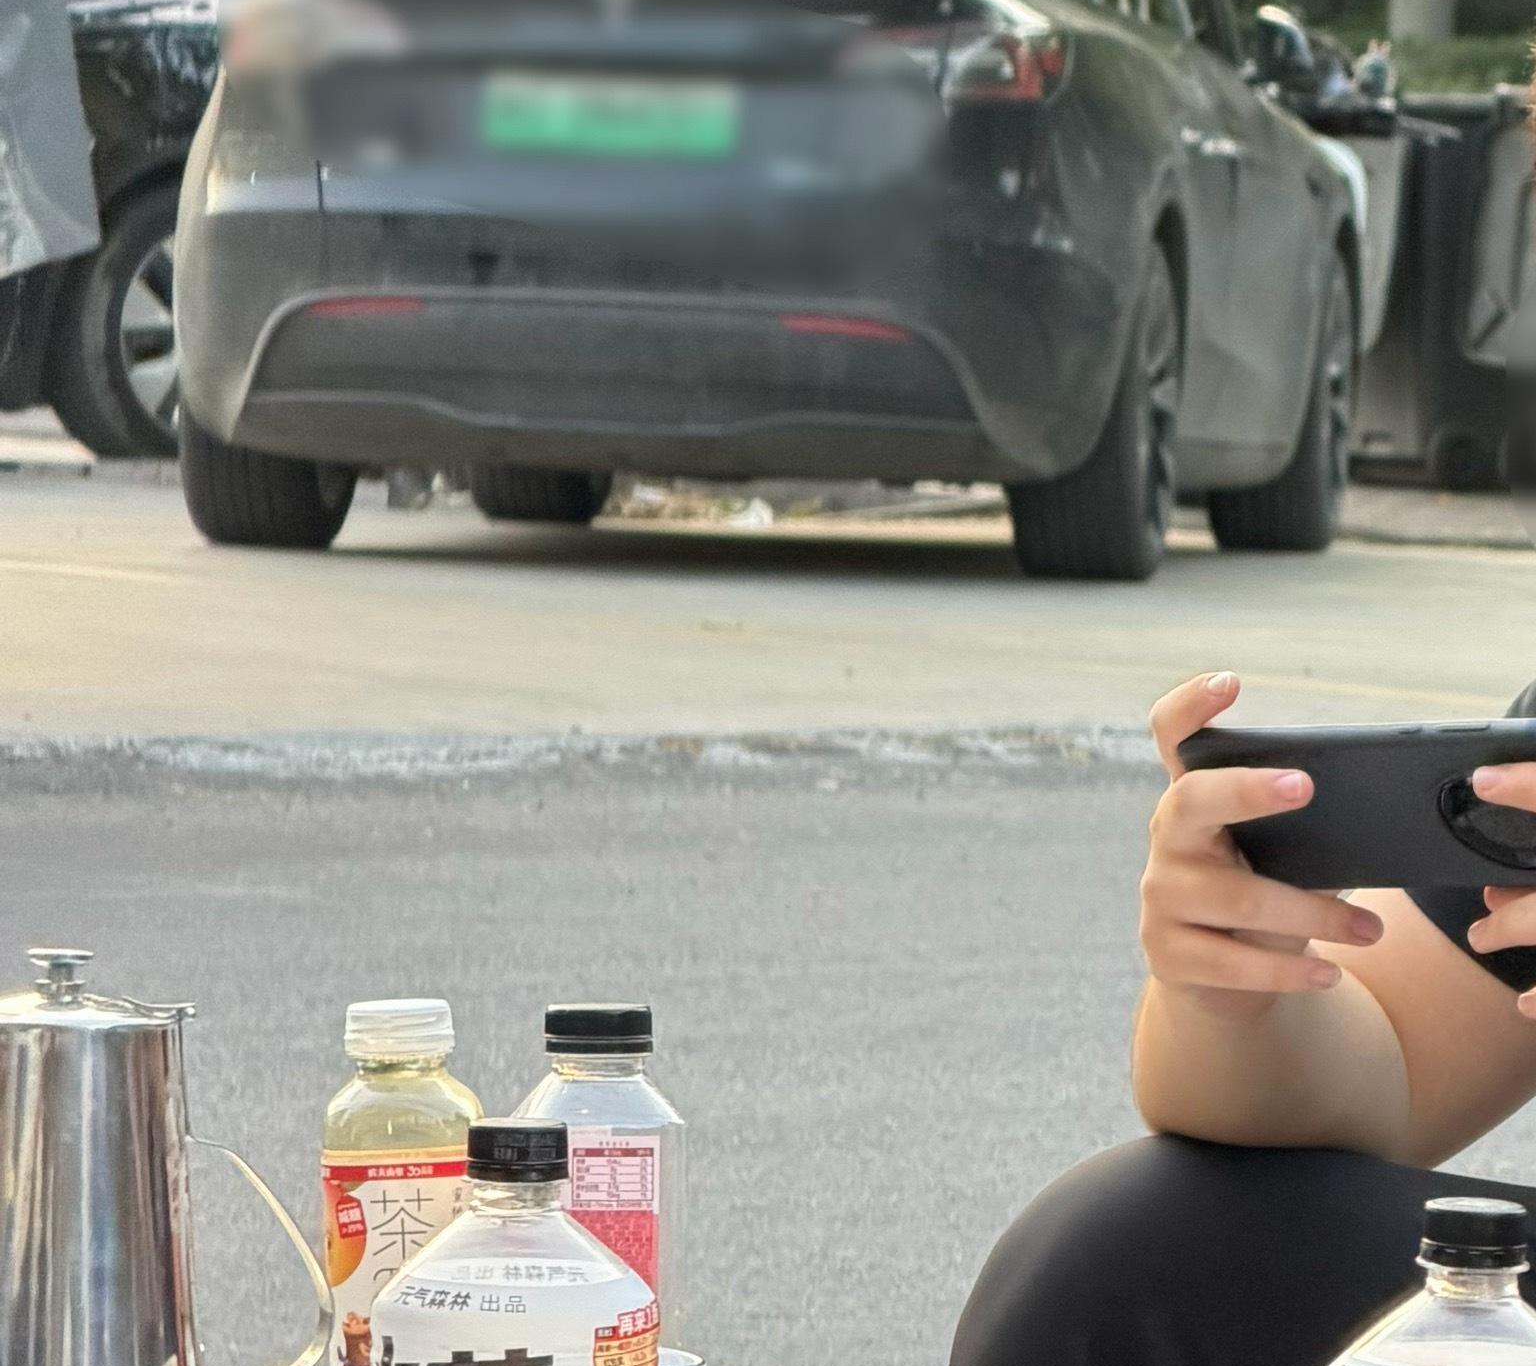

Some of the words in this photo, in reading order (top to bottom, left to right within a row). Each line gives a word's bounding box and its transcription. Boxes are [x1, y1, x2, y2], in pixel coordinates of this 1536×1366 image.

[394, 1285, 472, 1312] 元气森林
[480, 1293, 527, 1314] 出品
